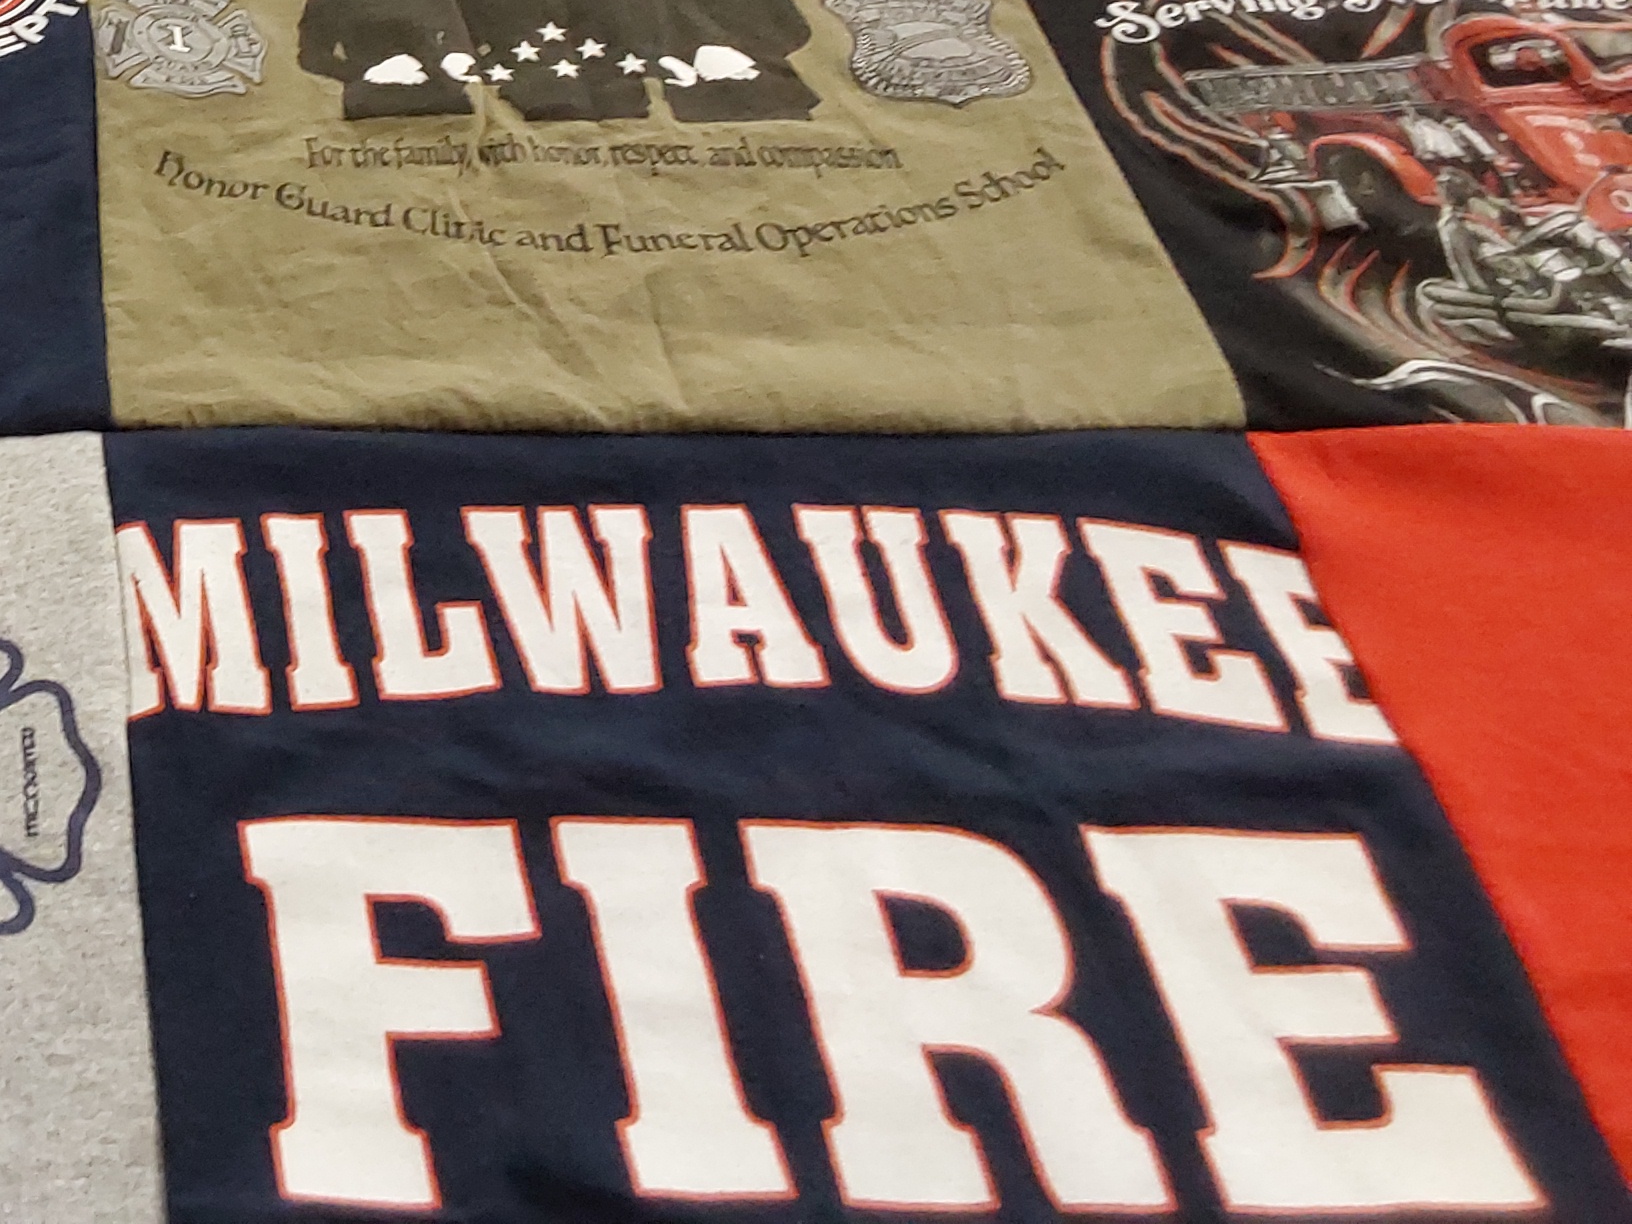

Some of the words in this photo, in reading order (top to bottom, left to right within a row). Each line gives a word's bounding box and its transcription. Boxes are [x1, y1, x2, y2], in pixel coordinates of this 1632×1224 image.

[274, 181, 394, 230] Guard
[402, 207, 508, 248] Clinic
[515, 224, 592, 253] and
[596, 222, 750, 257] Funeral
[755, 193, 958, 257] Operations
[955, 147, 1066, 209] School
[303, 136, 346, 169] For
[349, 137, 390, 168] the
[708, 137, 756, 168] and
[115, 505, 1399, 748] MILWAUKEE
[237, 815, 1552, 1216] FIRE
